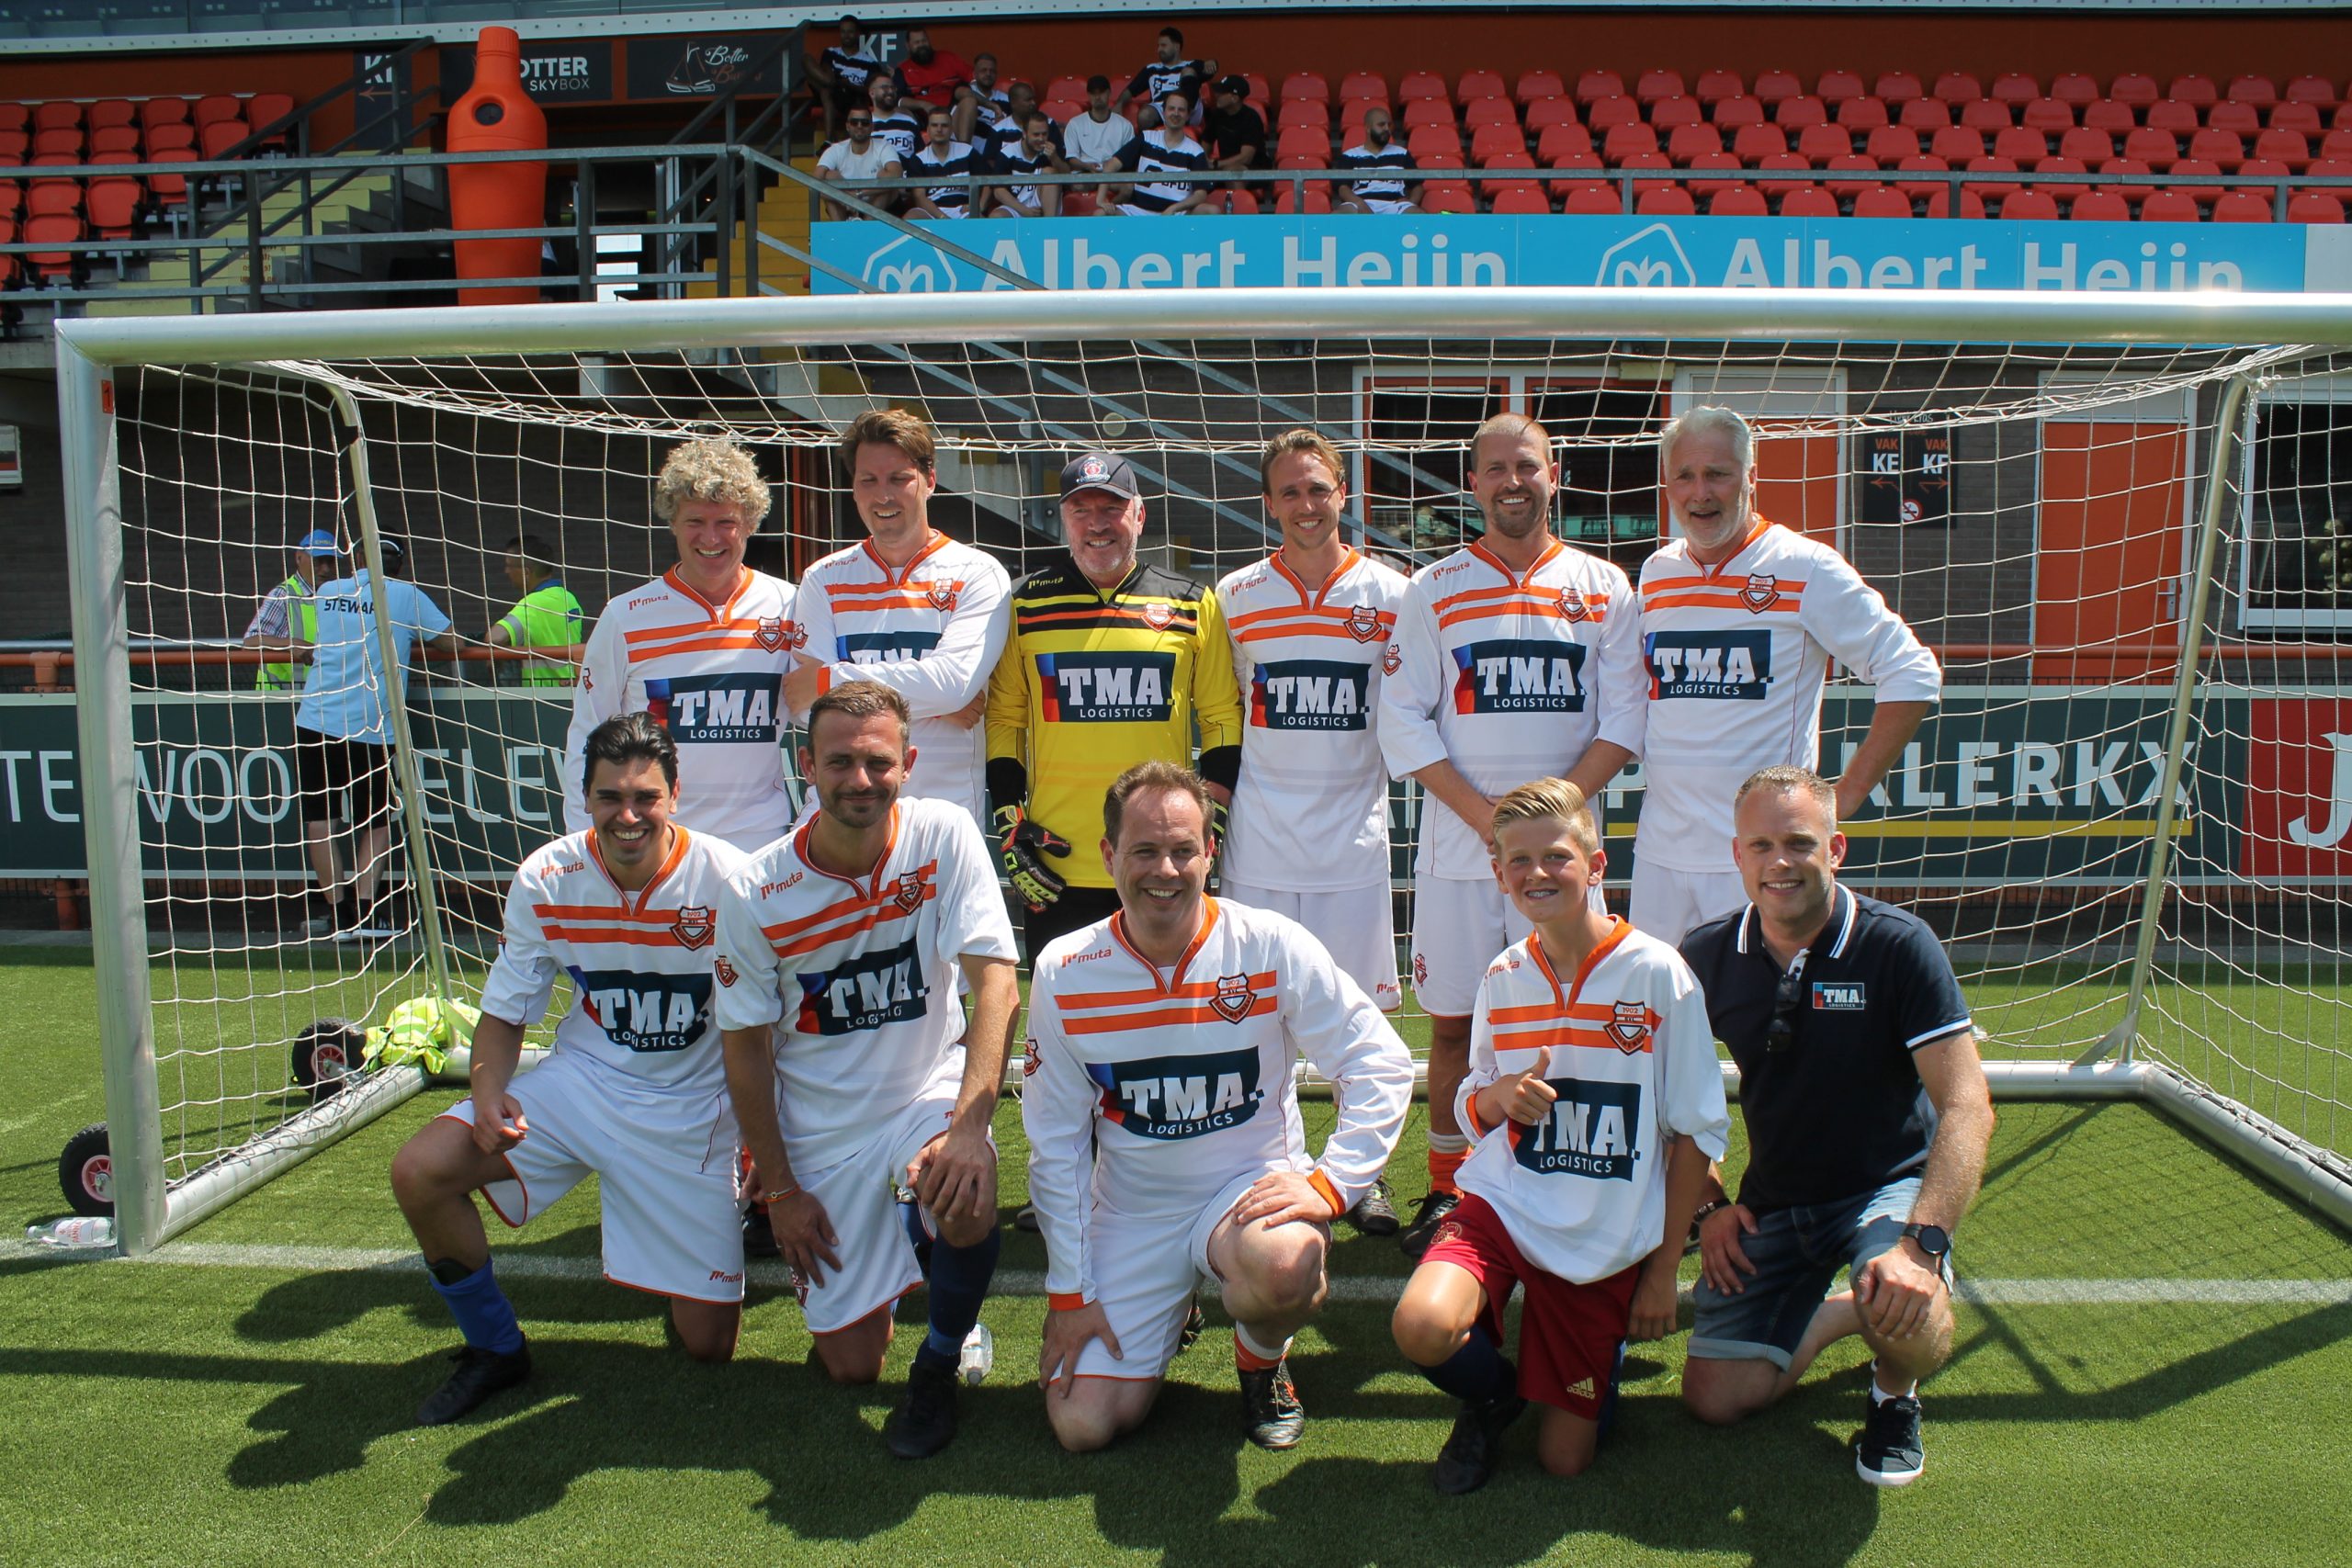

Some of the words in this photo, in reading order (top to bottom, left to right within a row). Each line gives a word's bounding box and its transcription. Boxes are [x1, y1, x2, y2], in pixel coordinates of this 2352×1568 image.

[529, 78, 590, 91] SKYBOX
[981, 238, 1246, 289] Albert
[1722, 238, 1986, 290] Albert
[1875, 438, 1899, 450] VAK
[1925, 438, 1949, 451] VAK
[1873, 453, 1899, 473] KE
[1923, 454, 1949, 475] KF
[1445, 561, 1470, 576] muta
[1039, 575, 1063, 586] muta
[1241, 575, 1268, 591] muta
[641, 593, 669, 606] muta
[1669, 683, 1740, 695] LOGISTICS
[1493, 698, 1566, 708] LOGISTICS
[1080, 707, 1153, 718] LOGISTICS
[1283, 716, 1349, 728] LOGISTICS
[690, 728, 761, 739] LOGISTICS
[554, 860, 585, 876] muta
[776, 871, 804, 894] muta
[1078, 947, 1112, 964] muta
[1148, 1112, 1234, 1135] LOGISTICS
[1540, 1154, 1612, 1173] LOGISTICS
[1566, 1385, 1596, 1400] adidas
